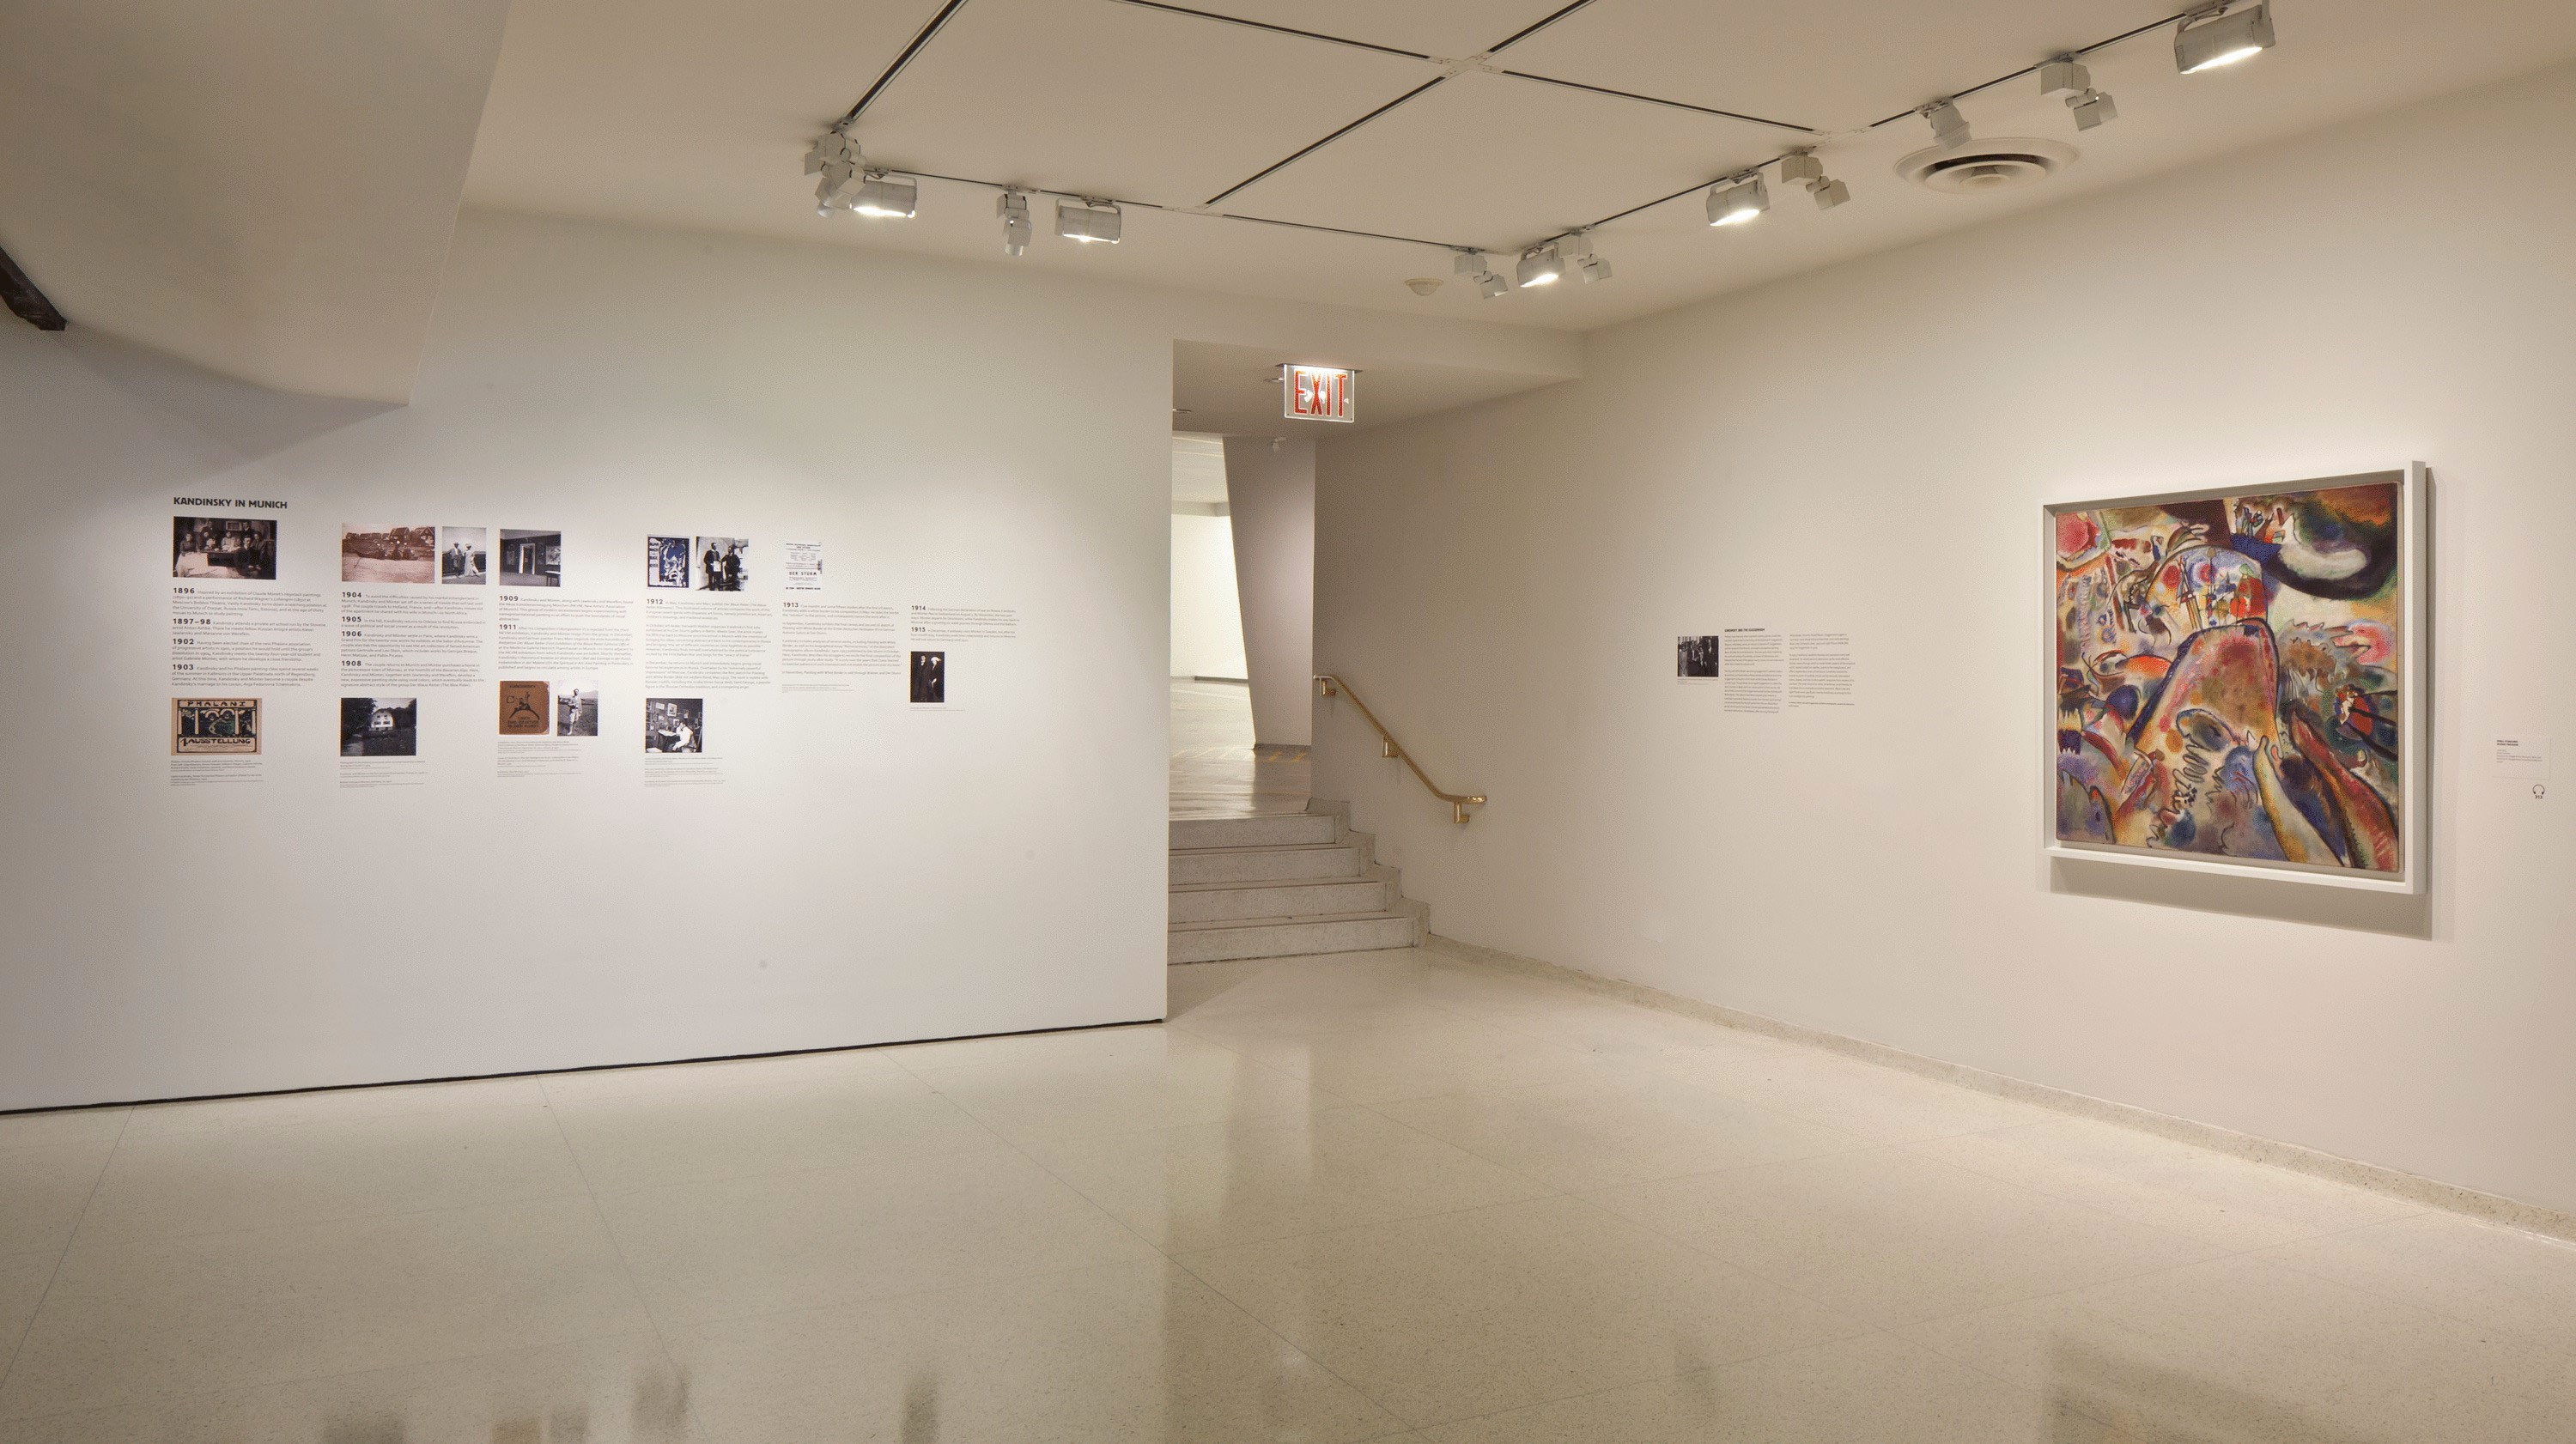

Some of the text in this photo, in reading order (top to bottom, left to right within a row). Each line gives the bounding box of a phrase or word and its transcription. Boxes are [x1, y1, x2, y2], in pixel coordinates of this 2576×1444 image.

[1294, 370, 1347, 416] EXIT
[173, 497, 232, 507] KANDINSKY
[248, 500, 288, 509] MUNICH
